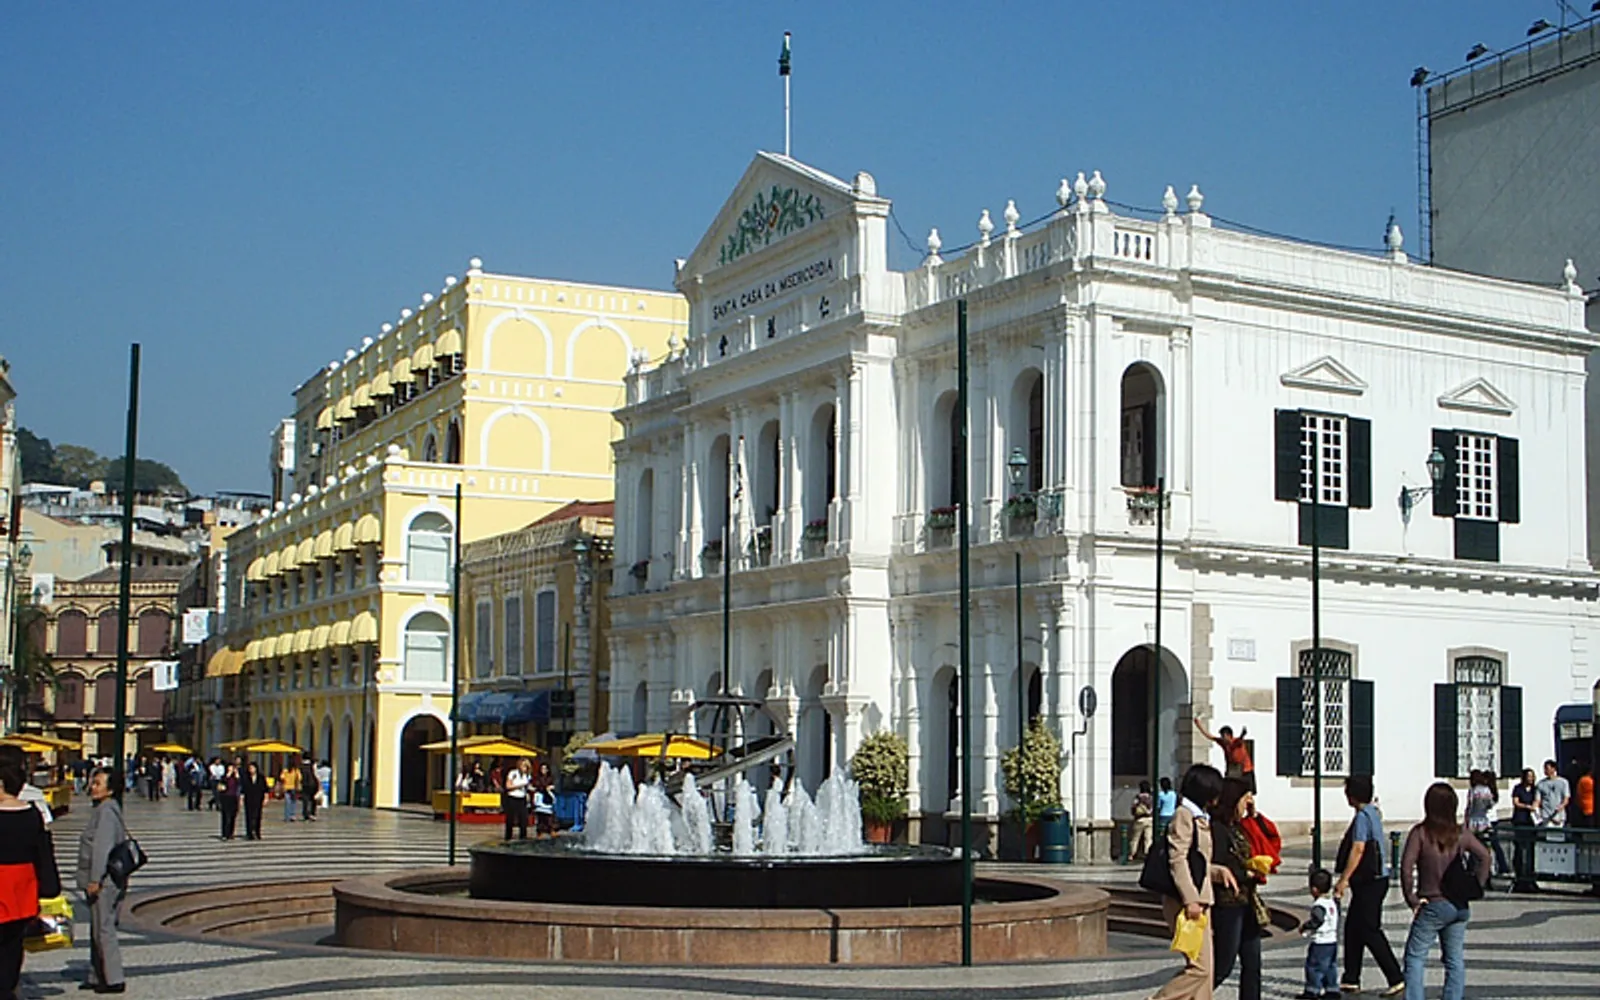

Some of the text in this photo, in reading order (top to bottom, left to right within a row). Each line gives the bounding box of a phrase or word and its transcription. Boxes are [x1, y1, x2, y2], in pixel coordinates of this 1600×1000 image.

[713, 298, 738, 320] SANTA
[740, 288, 763, 308] CASA
[765, 282, 777, 299] DA
